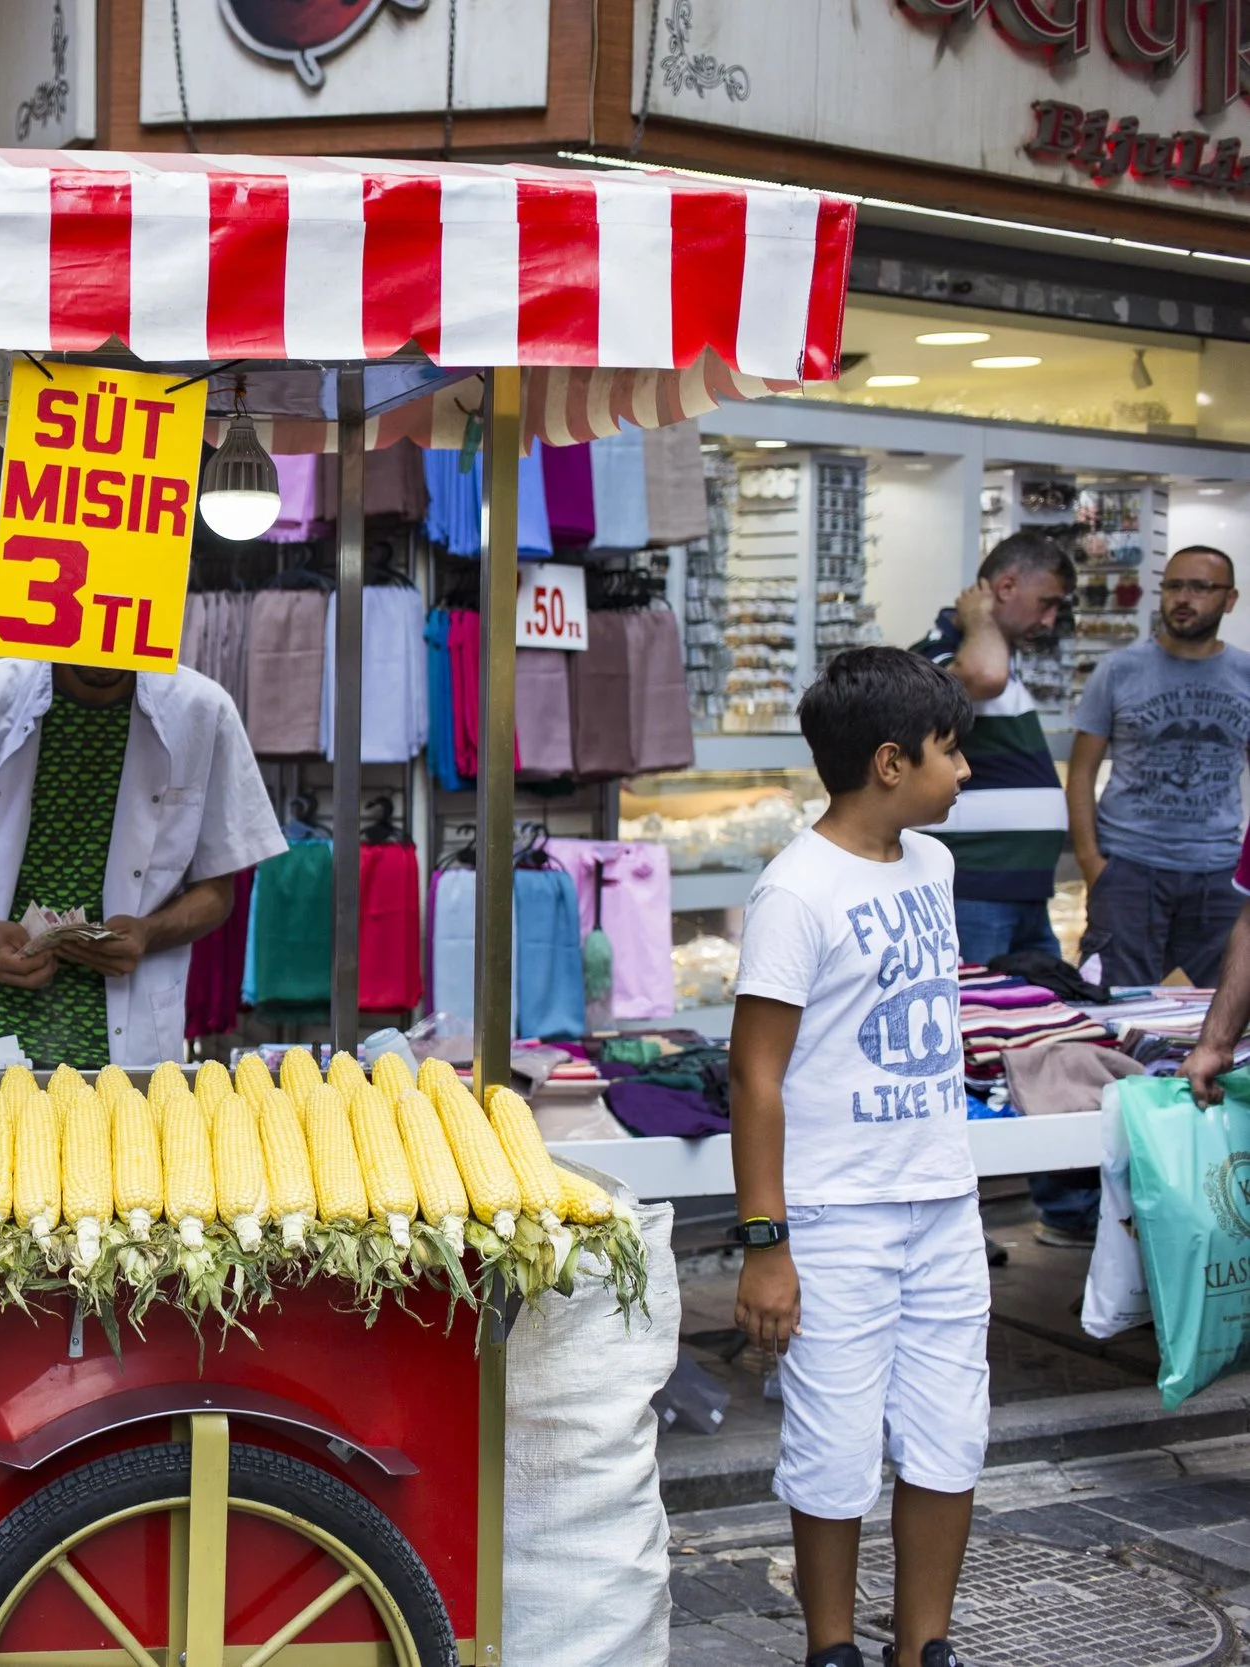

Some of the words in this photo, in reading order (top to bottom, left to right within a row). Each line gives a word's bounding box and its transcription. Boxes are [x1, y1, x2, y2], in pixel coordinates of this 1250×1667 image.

[34, 381, 175, 459] SÜT
[3, 459, 190, 537] MISIR
[93, 593, 173, 659] TL
[846, 879, 953, 956] FUNNY
[877, 928, 957, 991] GUYS
[879, 994, 960, 1066] LOOK
[852, 1080, 931, 1123] LIKE
[1204, 1256, 1250, 1289] KLAS
